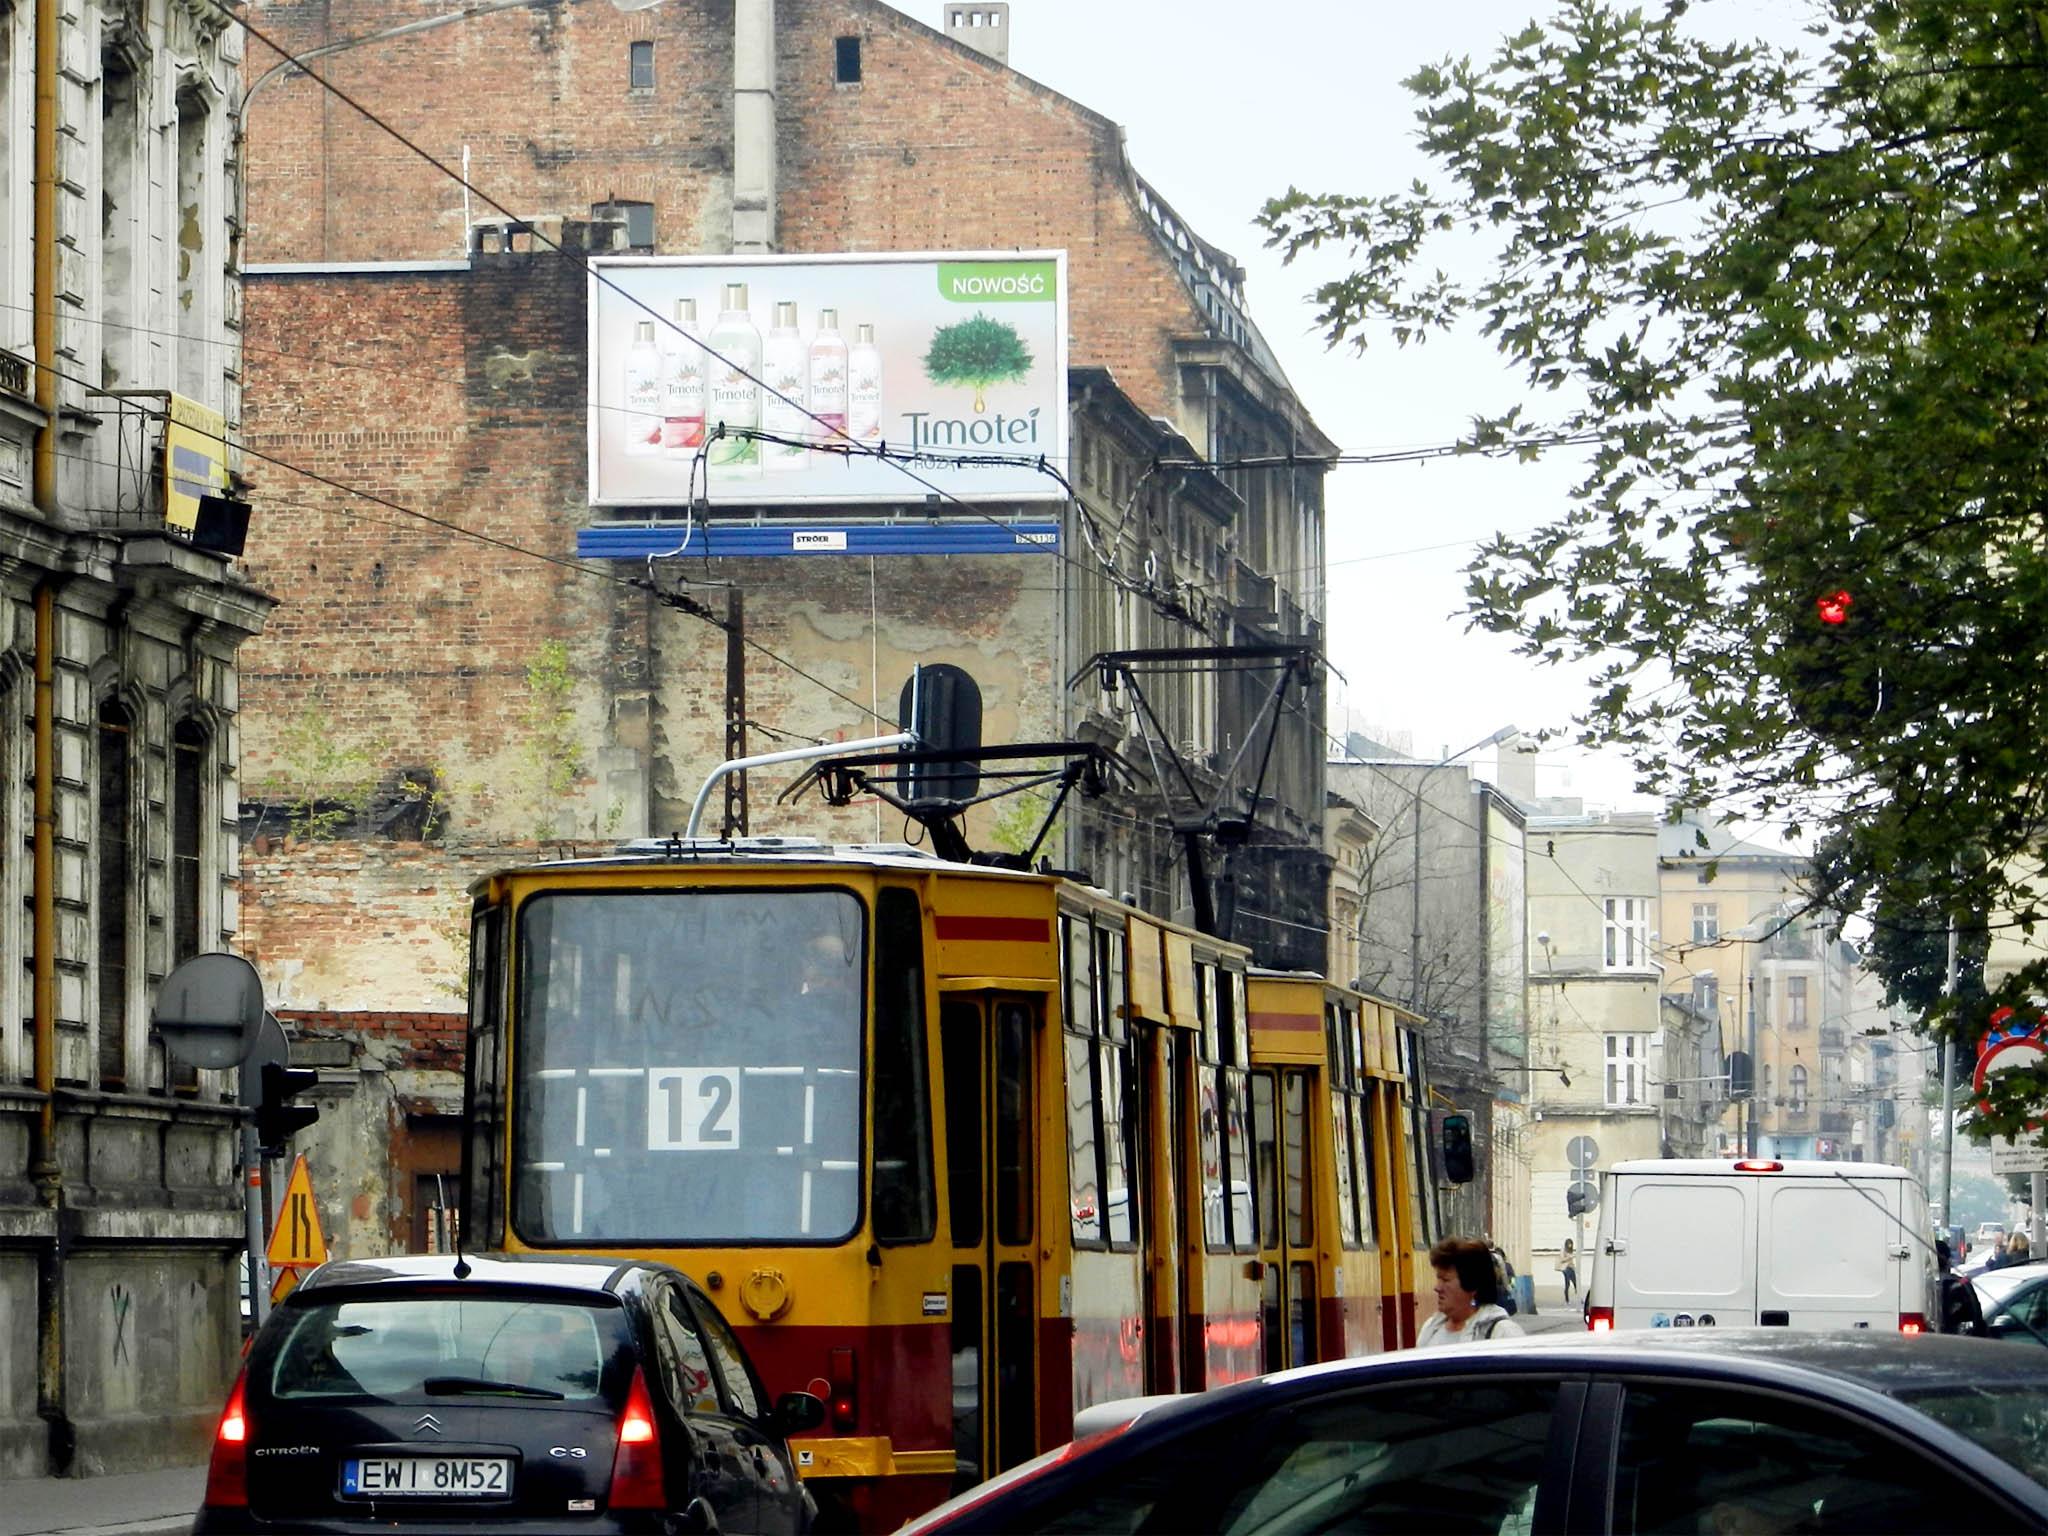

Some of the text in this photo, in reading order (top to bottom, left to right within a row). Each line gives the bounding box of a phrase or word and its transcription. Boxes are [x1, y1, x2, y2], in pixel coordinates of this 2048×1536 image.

[953, 273, 1044, 294] NOWOŚĆ
[712, 387, 757, 401] Timotei
[902, 407, 1040, 451] Timotei
[659, 1075, 733, 1143] 12
[255, 1445, 320, 1457] CITROËN
[549, 1447, 587, 1458] C3
[346, 1478, 356, 1486] PL
[362, 1461, 503, 1489] EWI 8M52
